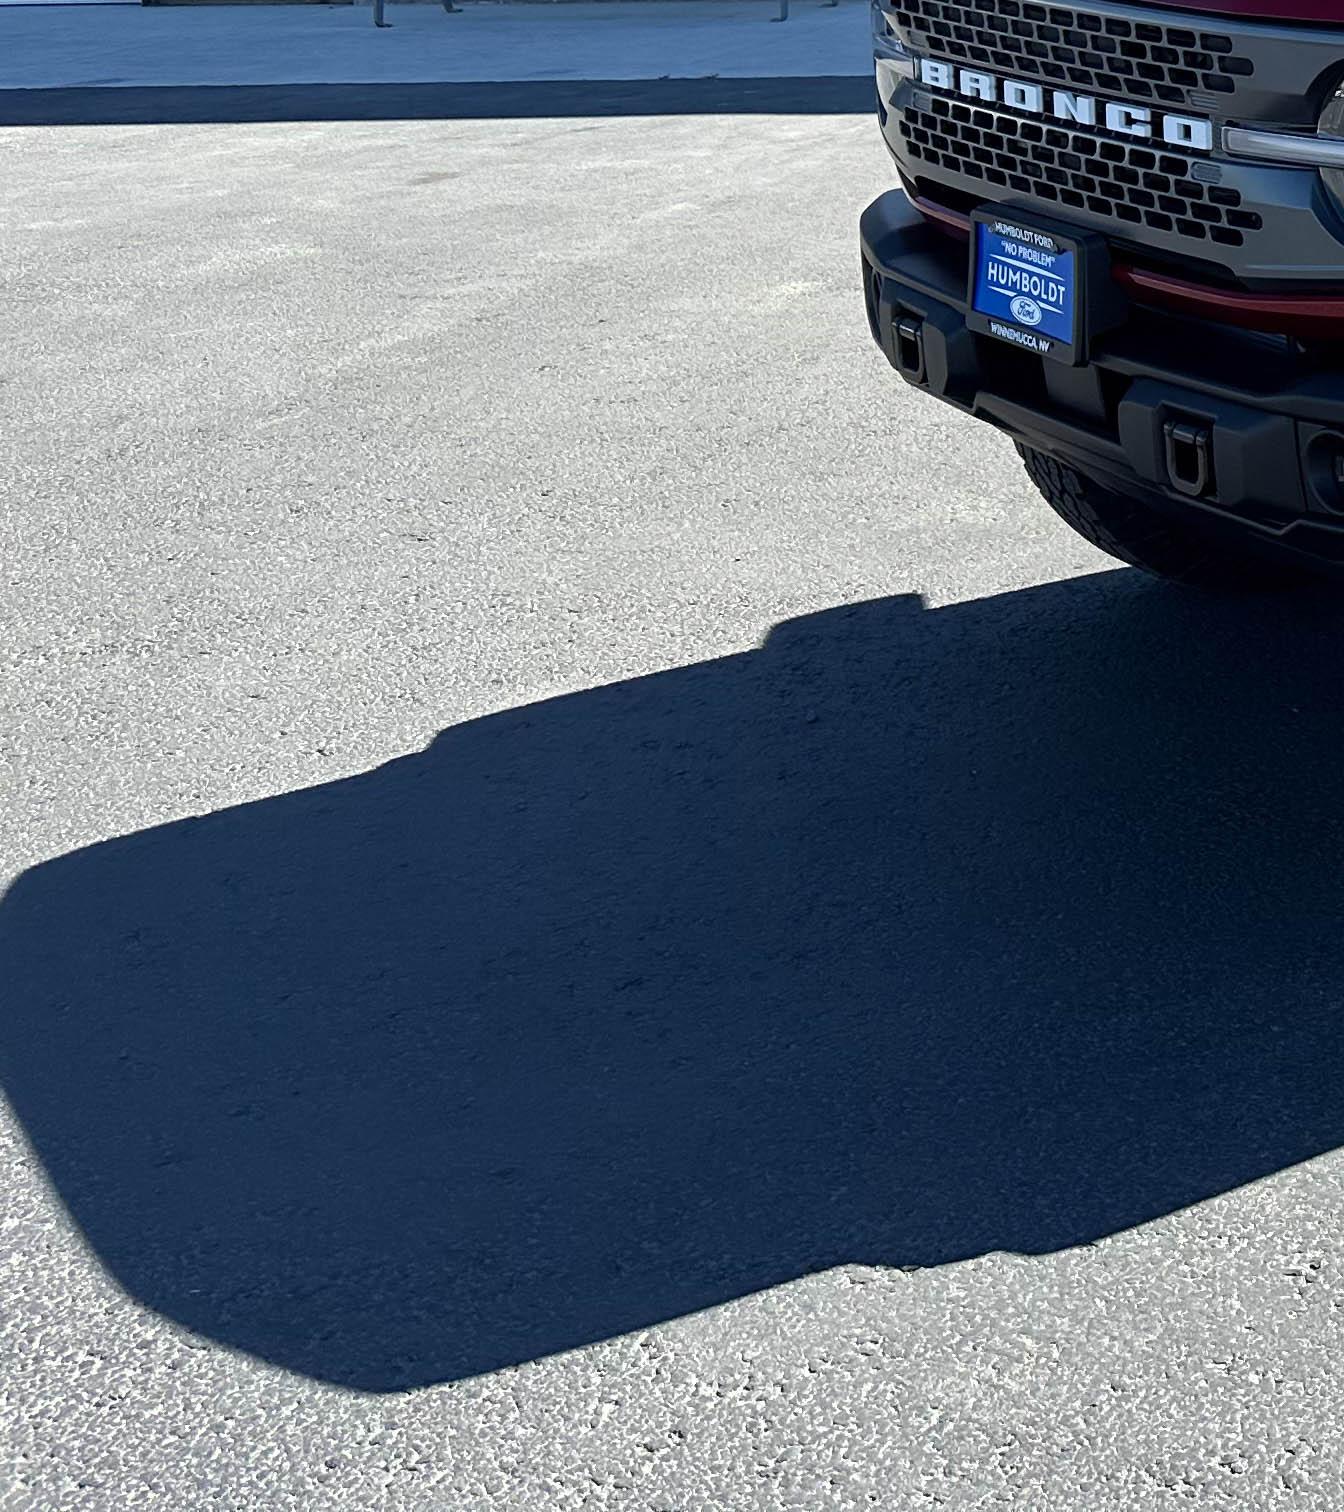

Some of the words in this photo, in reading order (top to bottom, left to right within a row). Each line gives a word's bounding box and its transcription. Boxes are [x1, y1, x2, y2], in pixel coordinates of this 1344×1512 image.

[919, 57, 1213, 151] BRONCO
[994, 221, 1034, 244] HUMBOLDT
[987, 261, 1067, 306] HUMBOLDT
[1017, 300, 1036, 321] Ford
[1038, 339, 1051, 353] NV
